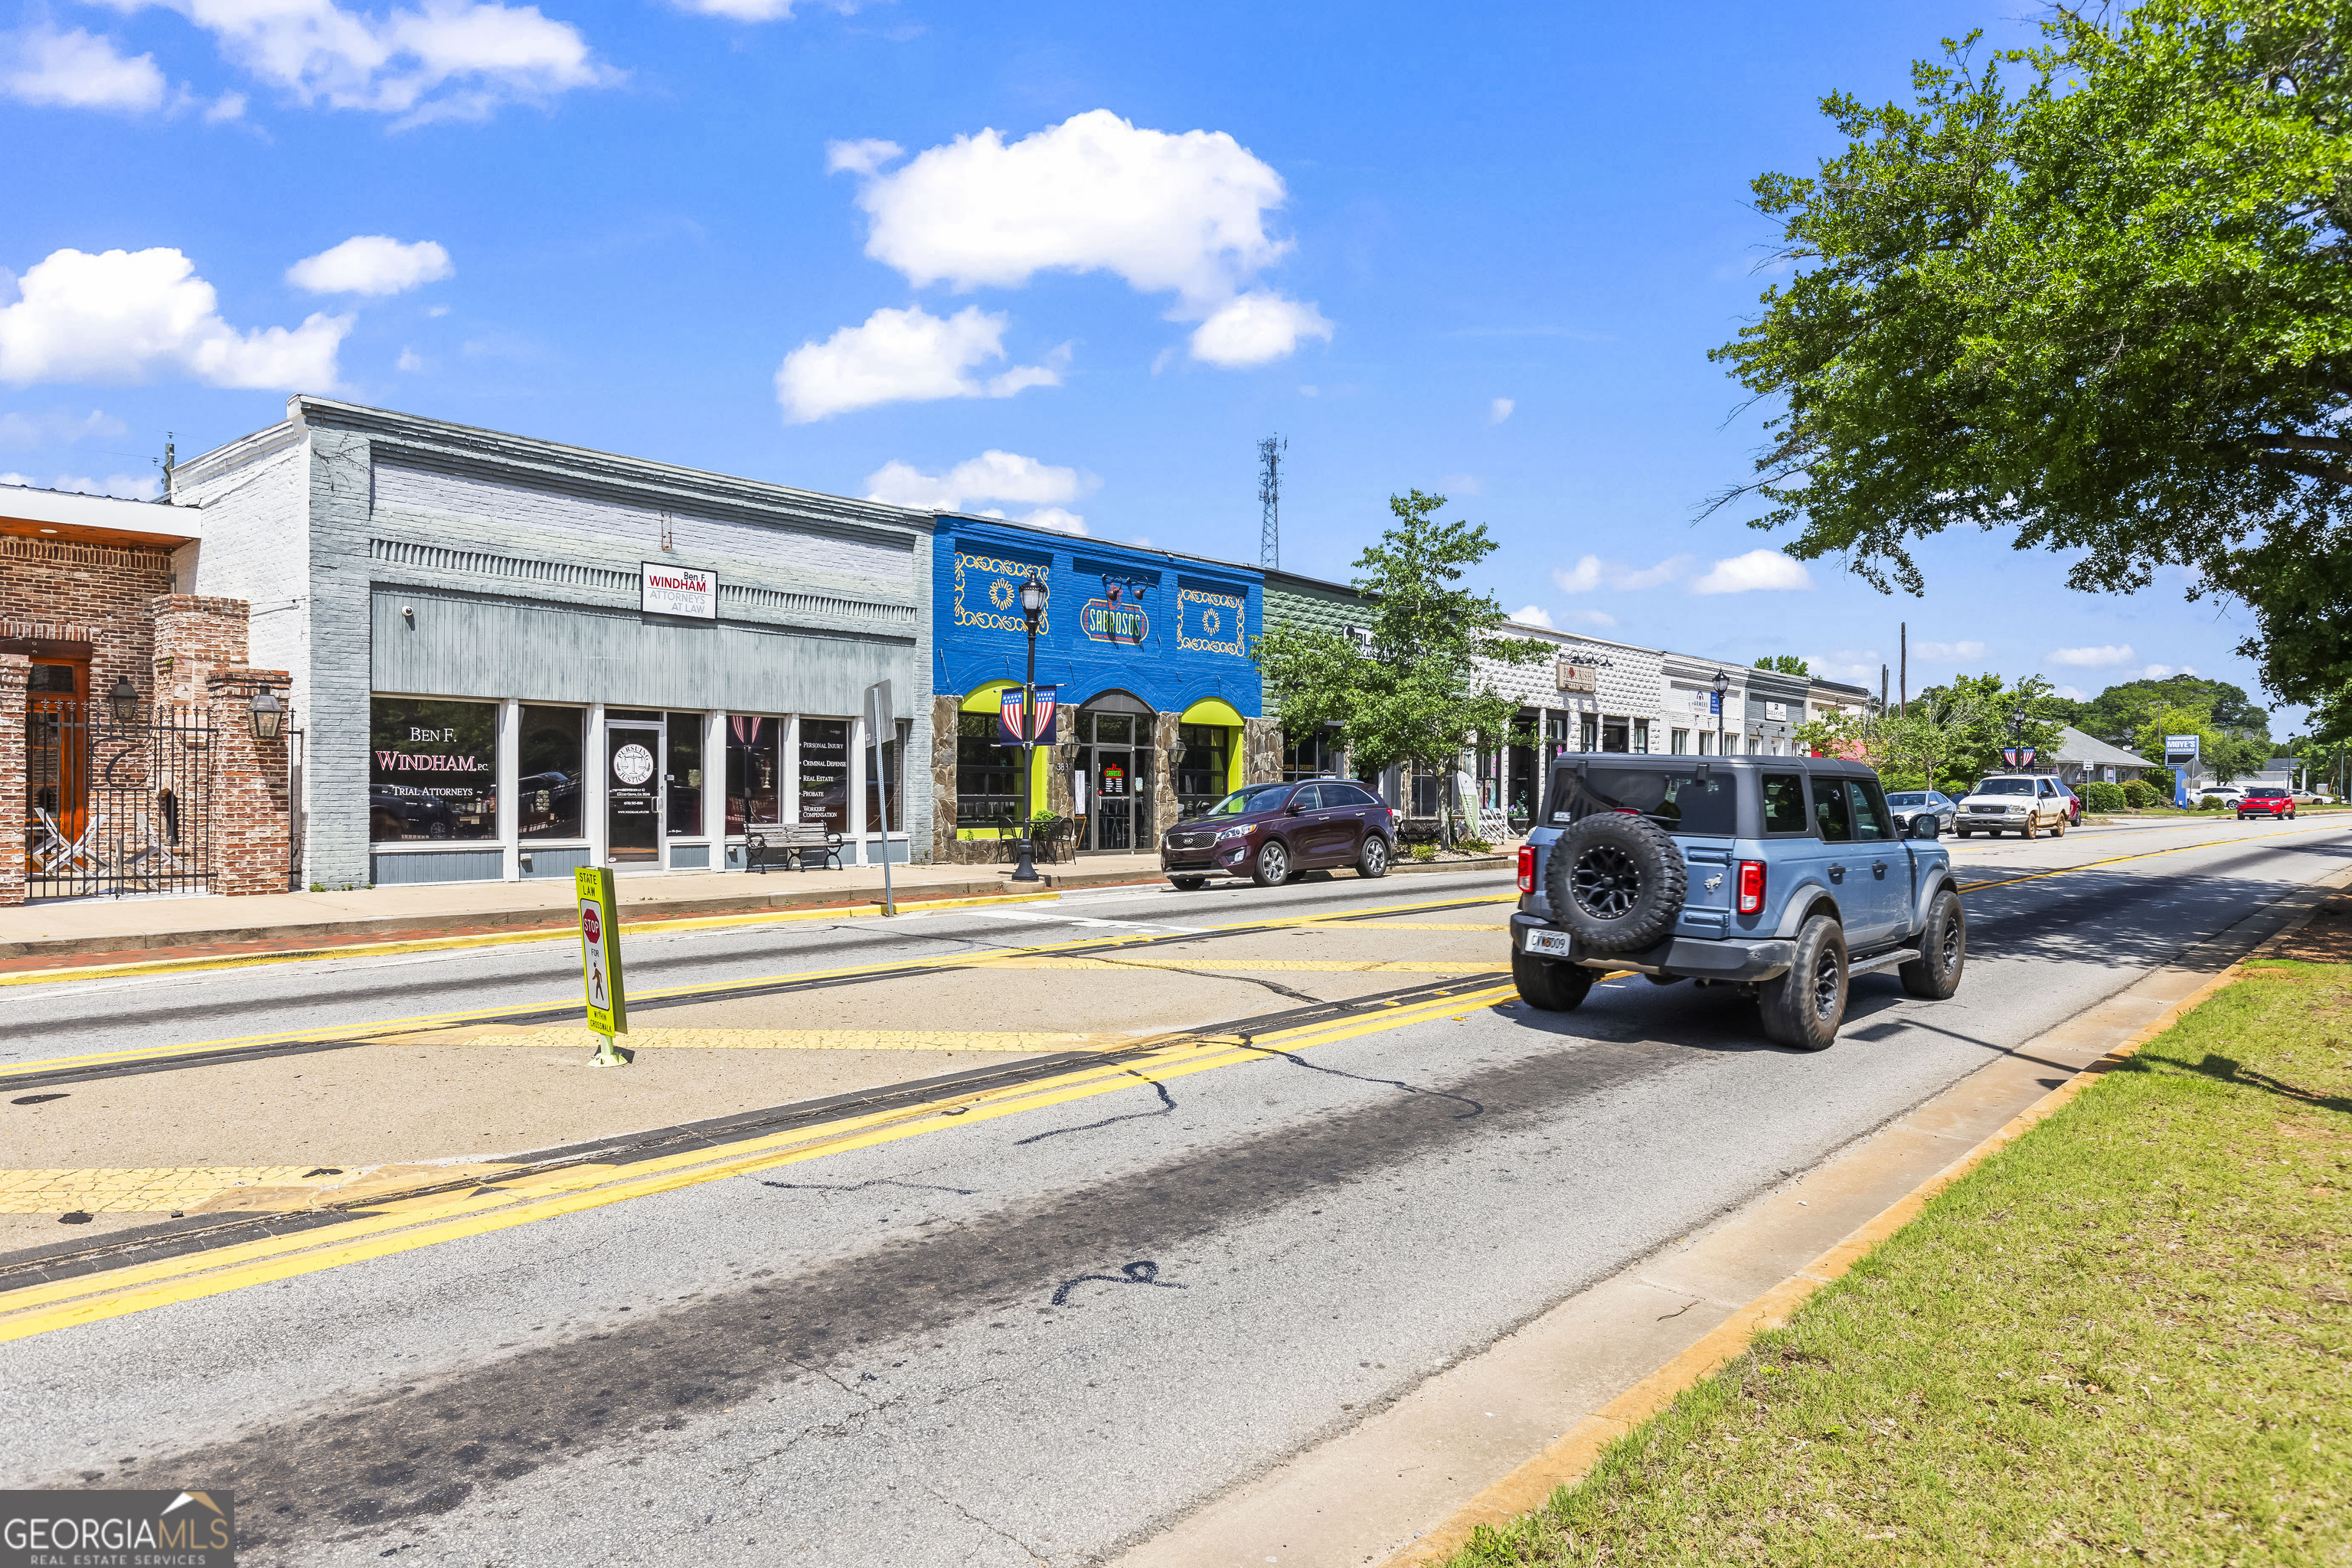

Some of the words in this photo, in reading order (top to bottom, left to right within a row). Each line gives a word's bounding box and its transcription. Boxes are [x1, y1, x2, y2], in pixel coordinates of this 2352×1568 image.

[684, 572, 698, 581] Ben
[649, 575, 706, 592] WINDHAM
[650, 590, 705, 604] ATTORNEYS
[671, 603, 683, 611] AT
[685, 604, 705, 614] LAW
[1090, 609, 1140, 636] SABROSOS
[410, 727, 440, 742] BEN
[443, 728, 457, 742] F.
[618, 746, 650, 760] PURSUING
[618, 772, 647, 783] JUSTICE
[392, 787, 420, 796] TRIAL
[422, 787, 473, 796] ATTORNEYS
[579, 873, 597, 885] STATE
[583, 885, 595, 897] LAW
[584, 918, 599, 934] STOP
[591, 949, 599, 957] FOR
[594, 1011, 607, 1021] WITHIN
[590, 1019, 612, 1033] CROSSWALK
